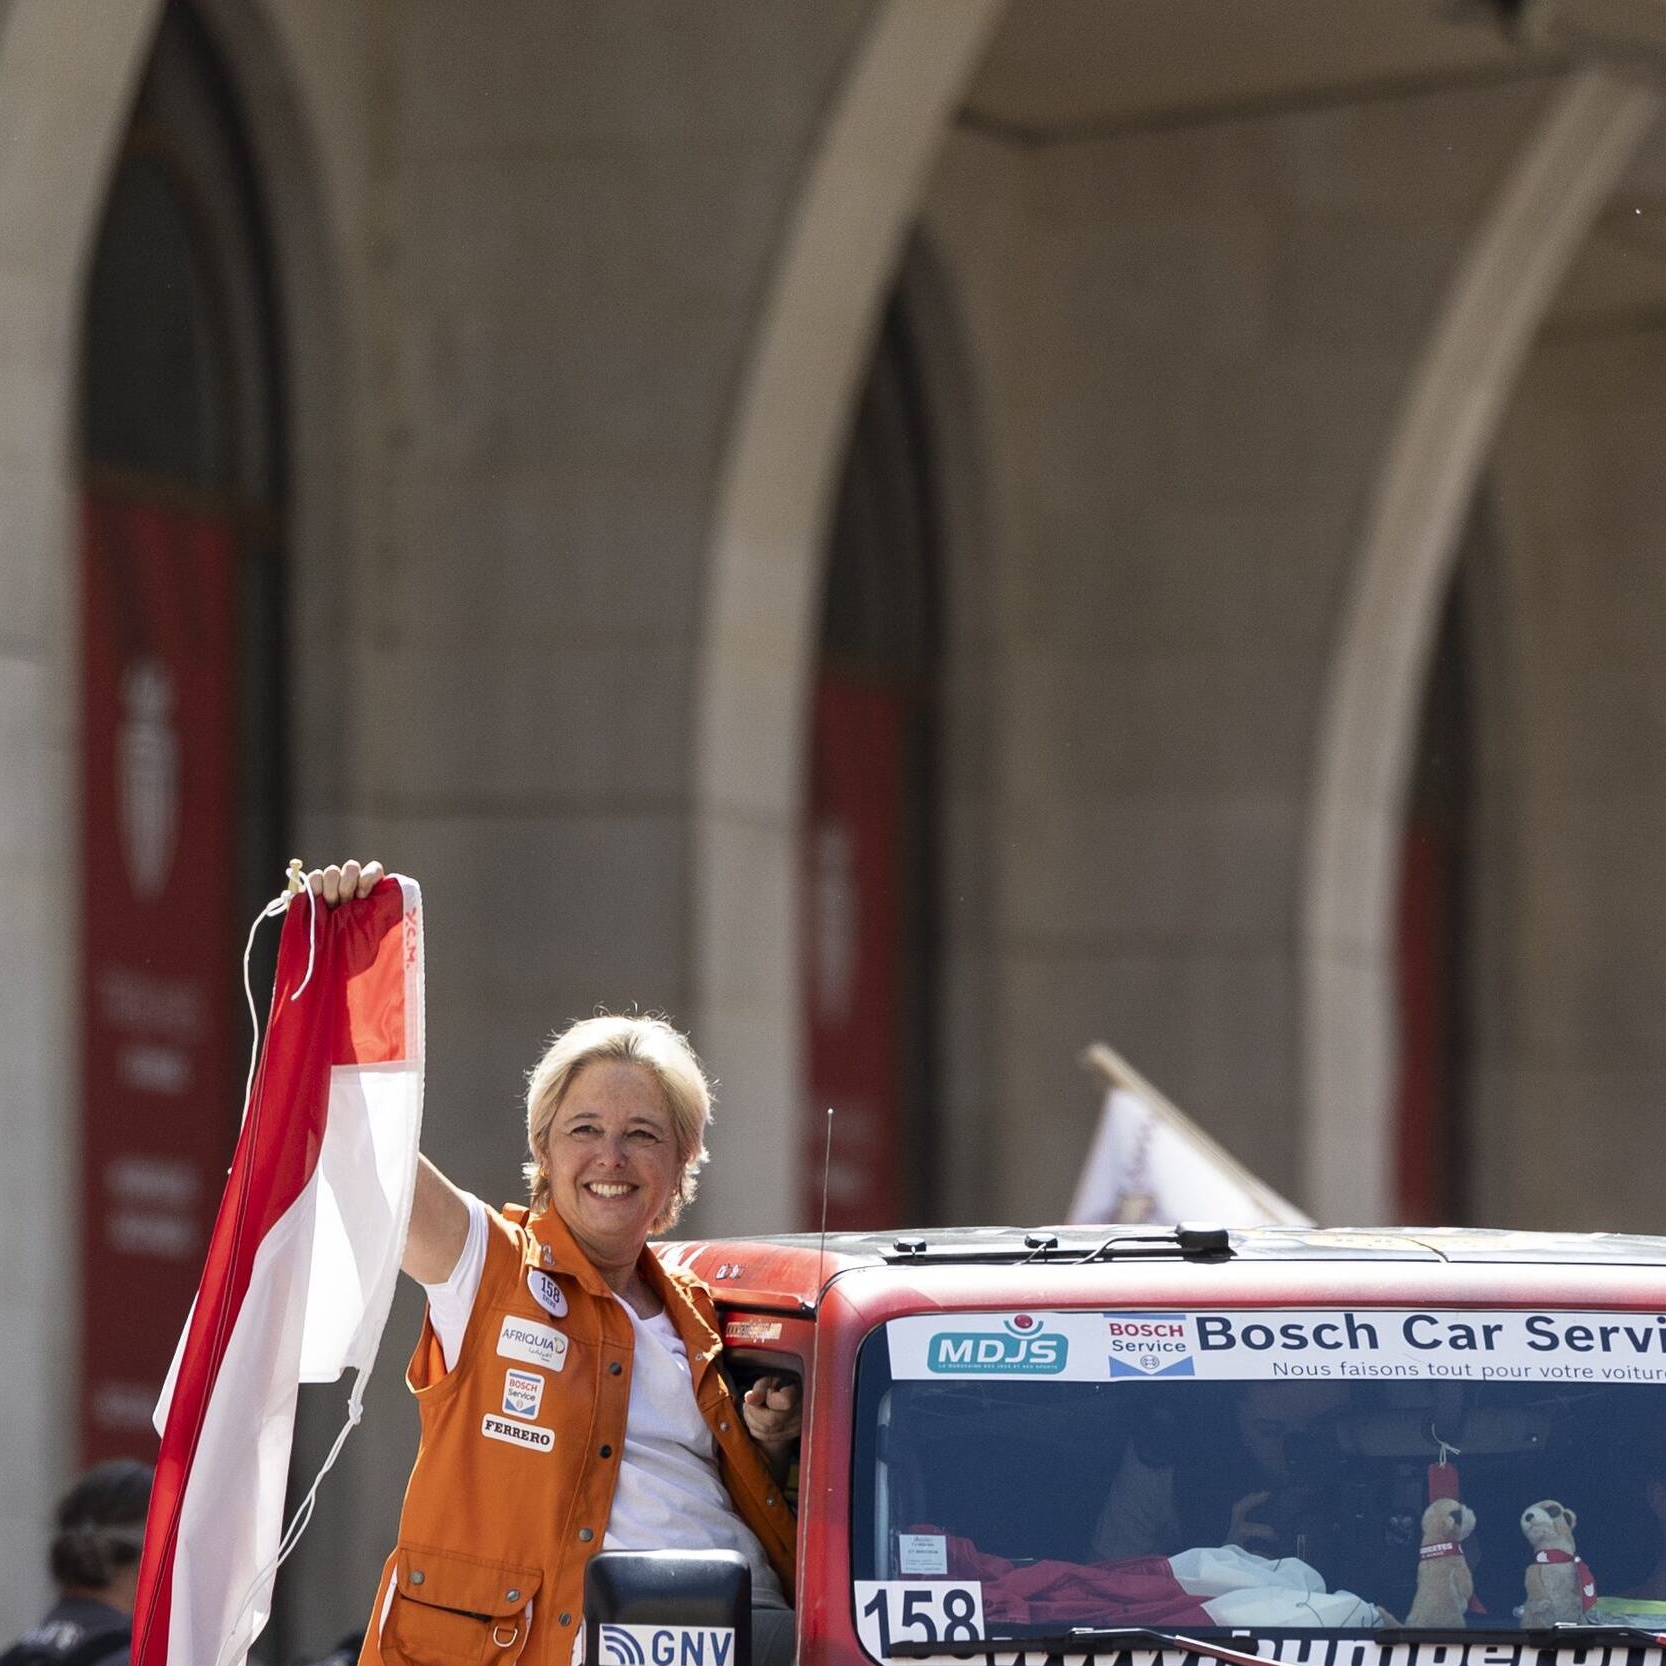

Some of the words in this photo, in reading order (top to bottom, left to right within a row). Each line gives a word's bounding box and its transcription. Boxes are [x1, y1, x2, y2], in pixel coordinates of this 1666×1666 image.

[540, 1276, 560, 1303] 158
[502, 1328, 554, 1352] AFRIQUIA
[1109, 1323, 1184, 1337] BOSCH
[1195, 1313, 1380, 1351] Bosch
[1401, 1313, 1503, 1352] Car
[938, 1338, 1057, 1363] MDJS
[1112, 1339, 1186, 1353] Service
[1271, 1361, 1331, 1376] Nous
[1339, 1360, 1419, 1376] faisons
[1428, 1362, 1473, 1377] tout
[1481, 1364, 1532, 1381] pour
[1539, 1365, 1595, 1380] votre
[508, 1388, 536, 1402] Service
[509, 1378, 538, 1392] BOSCH
[484, 1419, 551, 1446] FERRERO
[863, 1588, 980, 1660] 158
